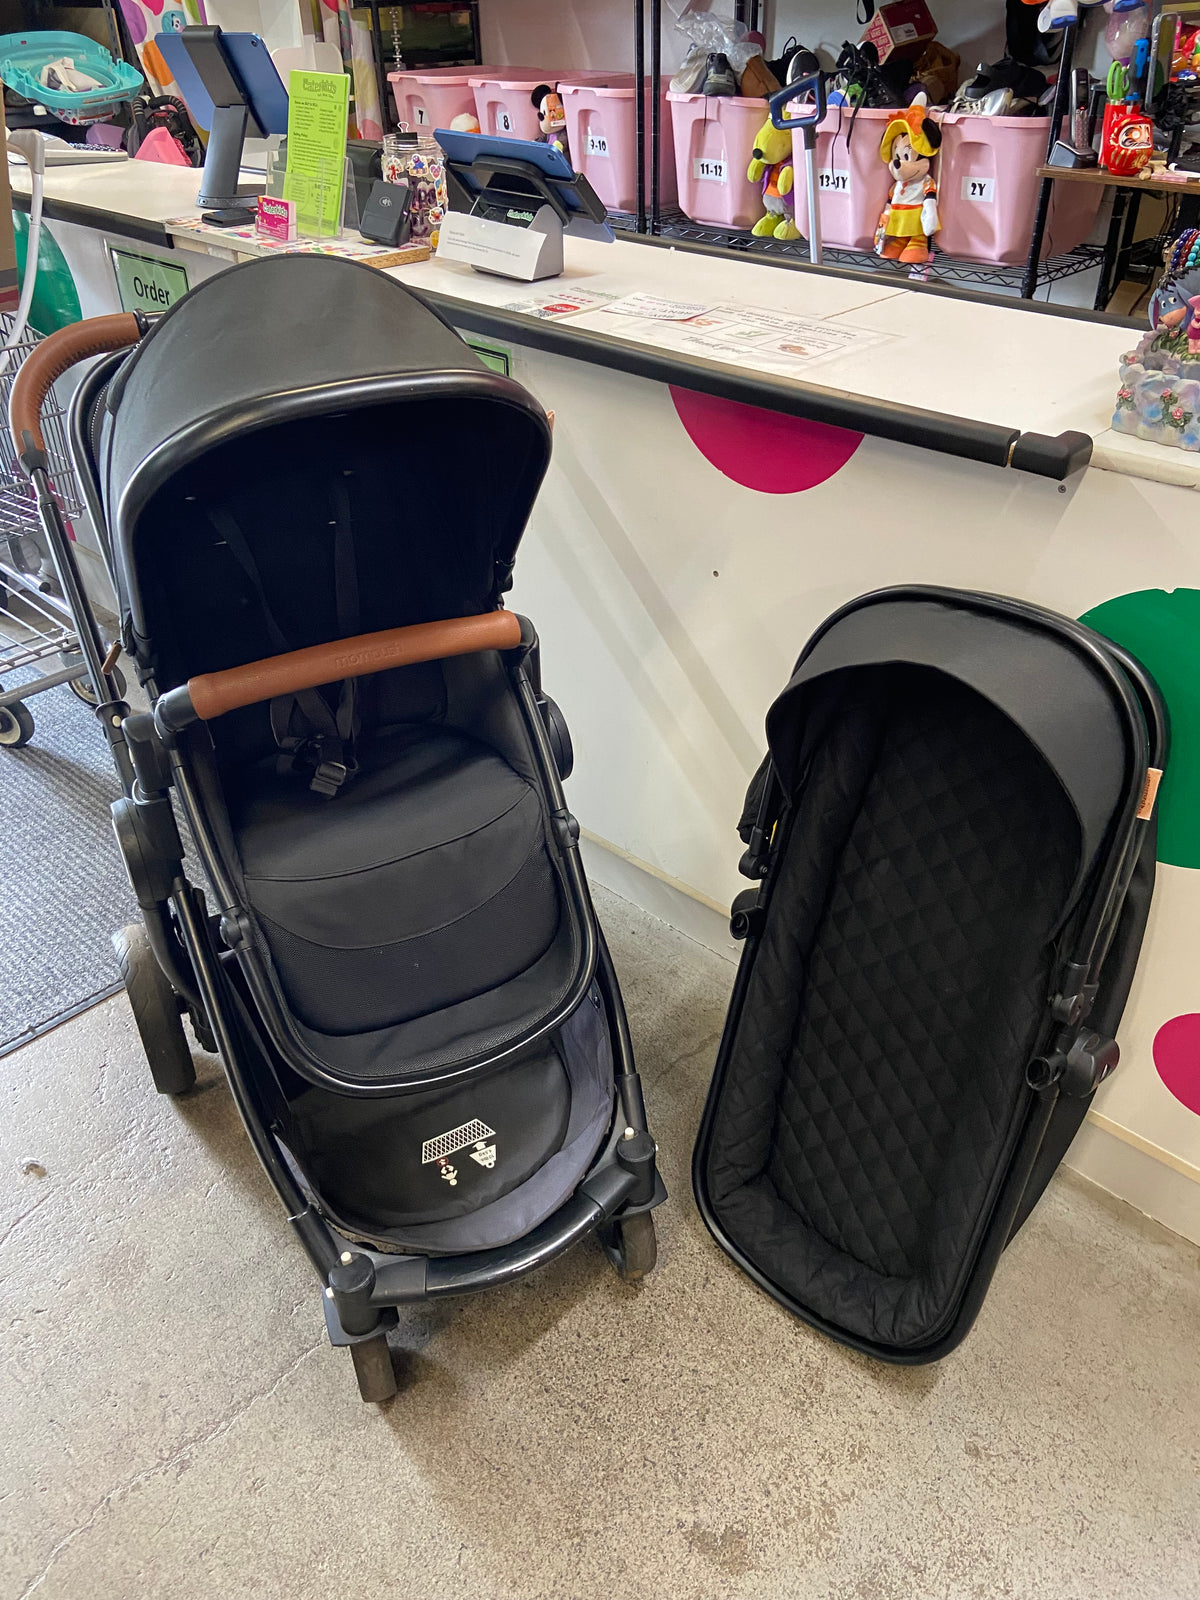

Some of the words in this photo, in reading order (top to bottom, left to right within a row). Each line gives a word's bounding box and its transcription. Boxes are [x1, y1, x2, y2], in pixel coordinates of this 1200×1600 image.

[418, 109, 424, 124] 7
[503, 114, 510, 130] 8
[700, 163, 723, 177] 11-12
[819, 174, 848, 189] 13-1Y
[970, 182, 986, 196] 2Y
[133, 276, 170, 306] Order
